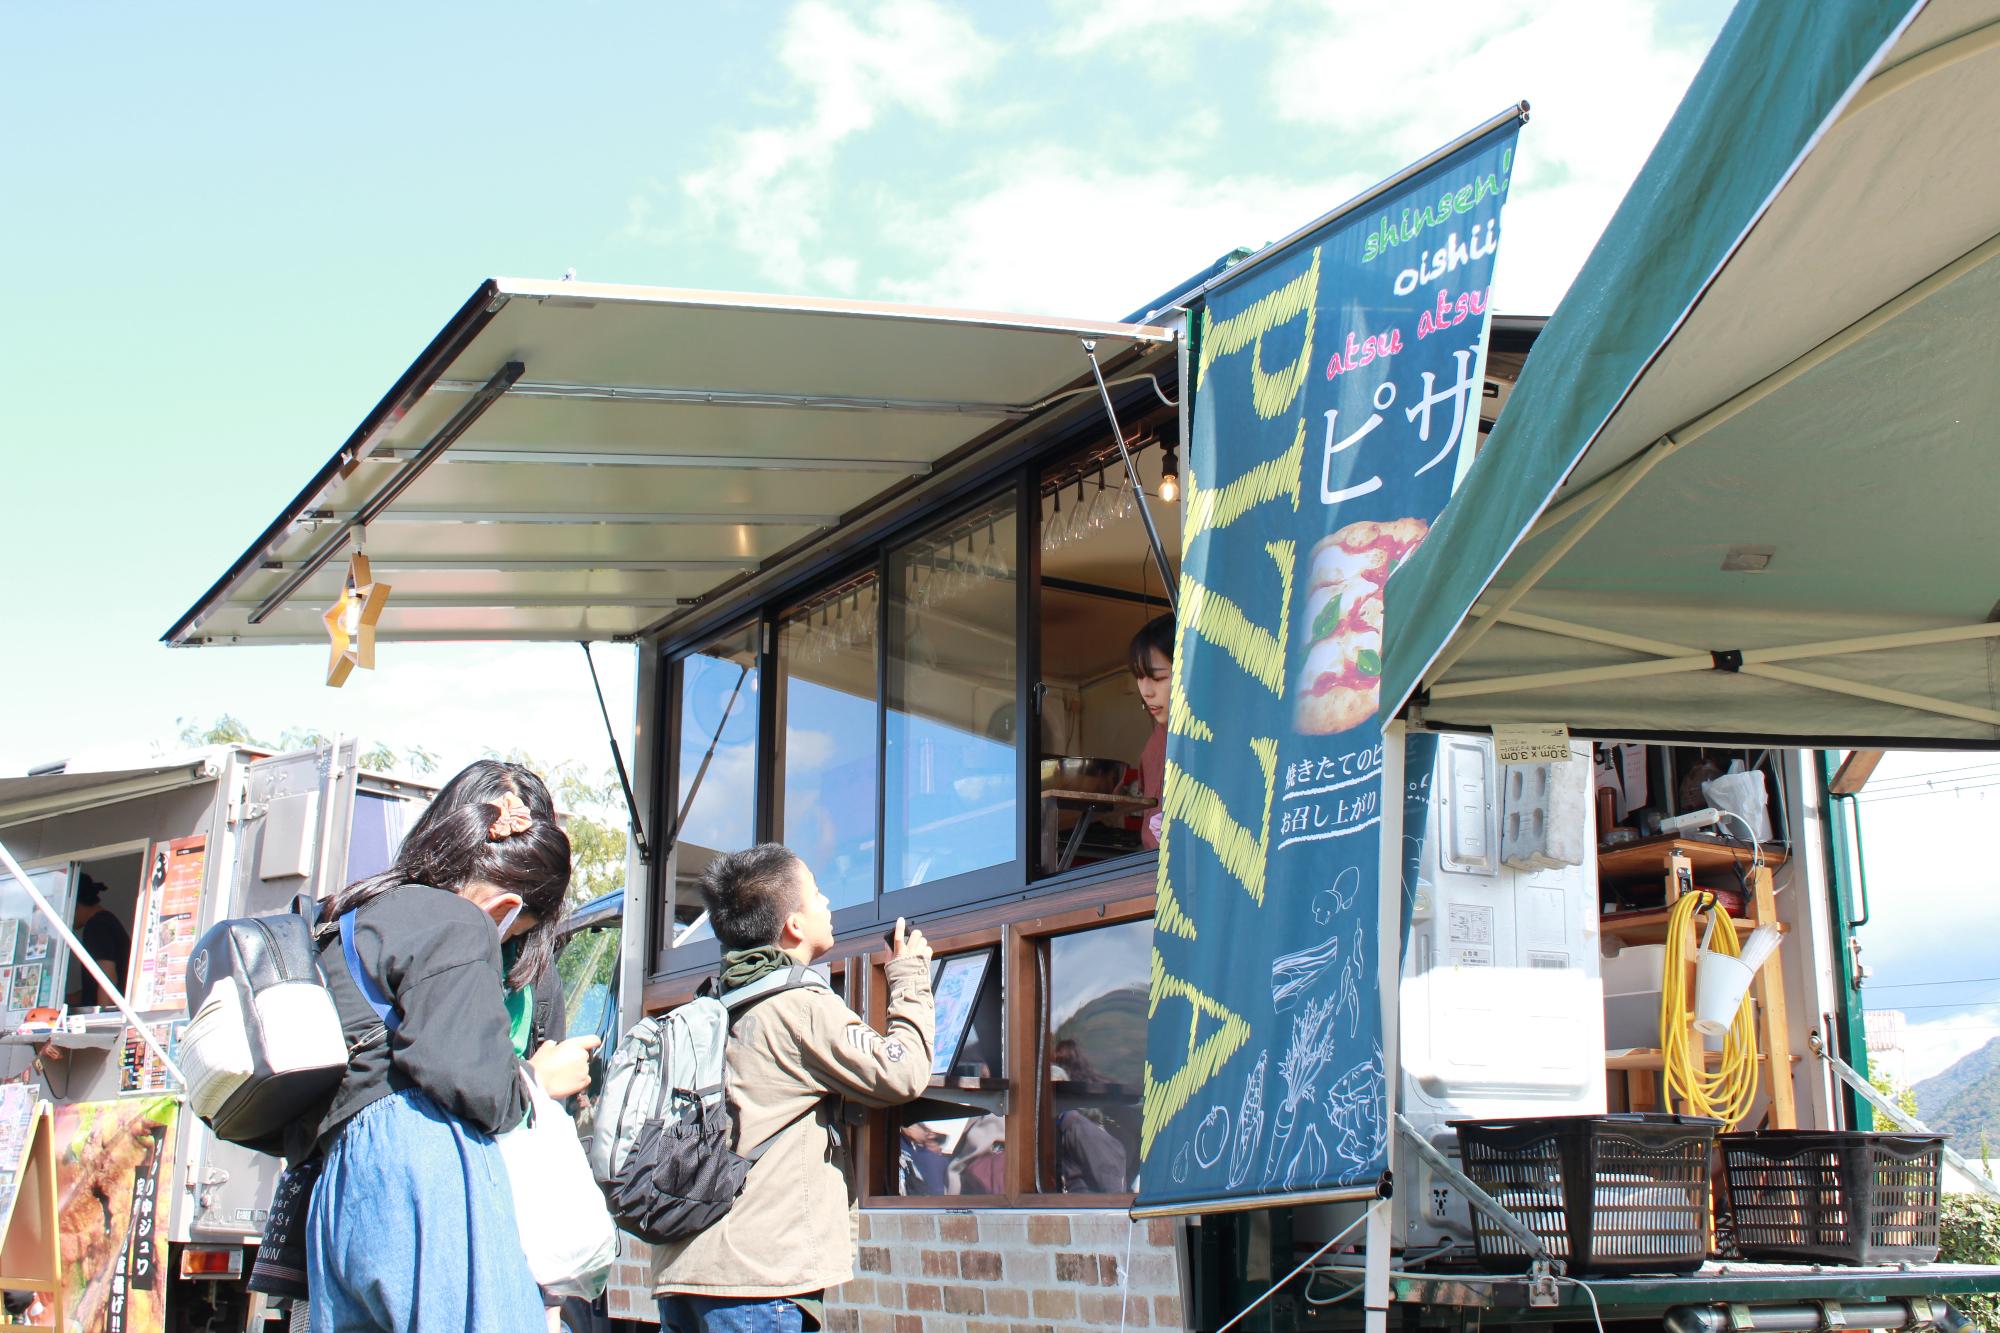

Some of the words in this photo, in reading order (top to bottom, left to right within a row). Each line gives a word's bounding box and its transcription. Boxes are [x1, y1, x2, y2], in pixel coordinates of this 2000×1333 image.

[1362, 149, 1511, 263] shinsen!
[1327, 329, 1404, 381] atsu
[1417, 286, 1492, 340] atsu
[1320, 334, 1481, 505] ピザ
[1140, 246, 1321, 1163] PIZZA
[1500, 751, 1528, 761] 3.0m
[1541, 750, 1568, 759] 3.0m
[1280, 791, 1376, 835] お召し上がり
